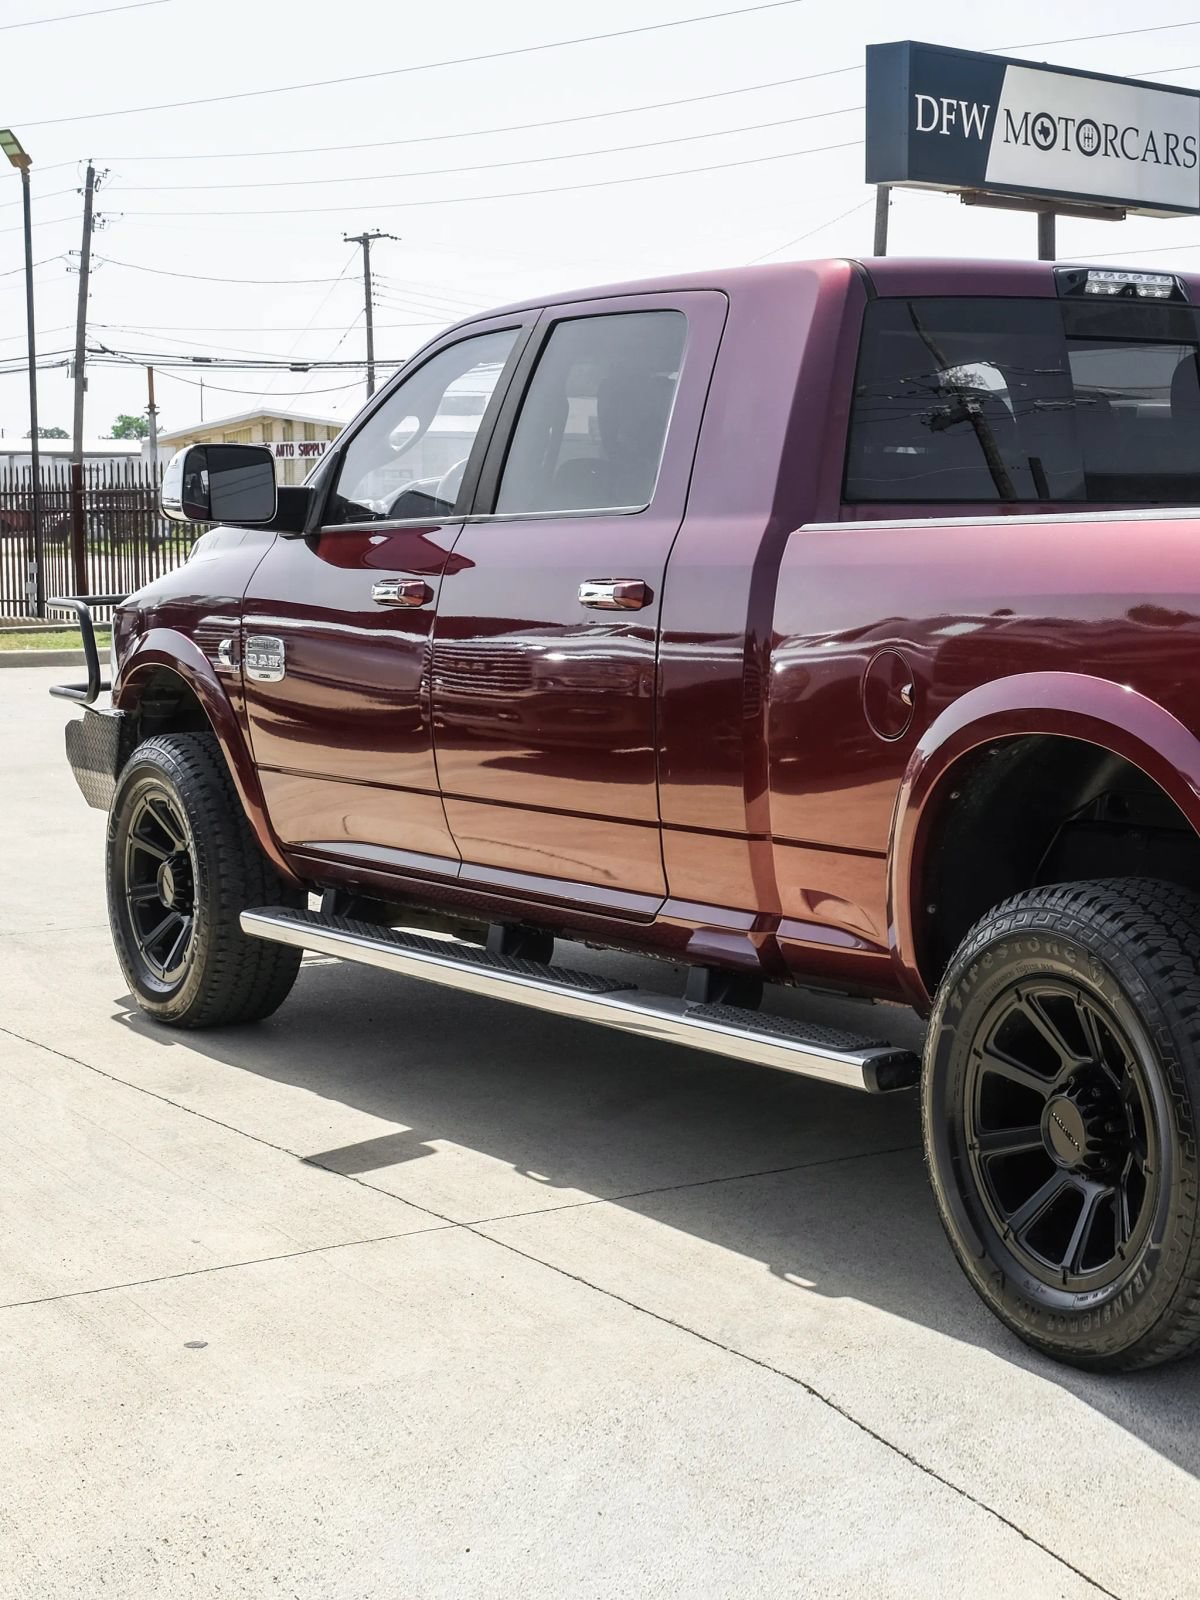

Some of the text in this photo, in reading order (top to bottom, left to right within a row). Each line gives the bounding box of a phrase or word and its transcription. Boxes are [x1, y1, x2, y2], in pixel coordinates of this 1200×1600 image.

[914, 93, 1198, 169] DFW MOTORCARS
[275, 442, 327, 458] AUTO SUPPLY
